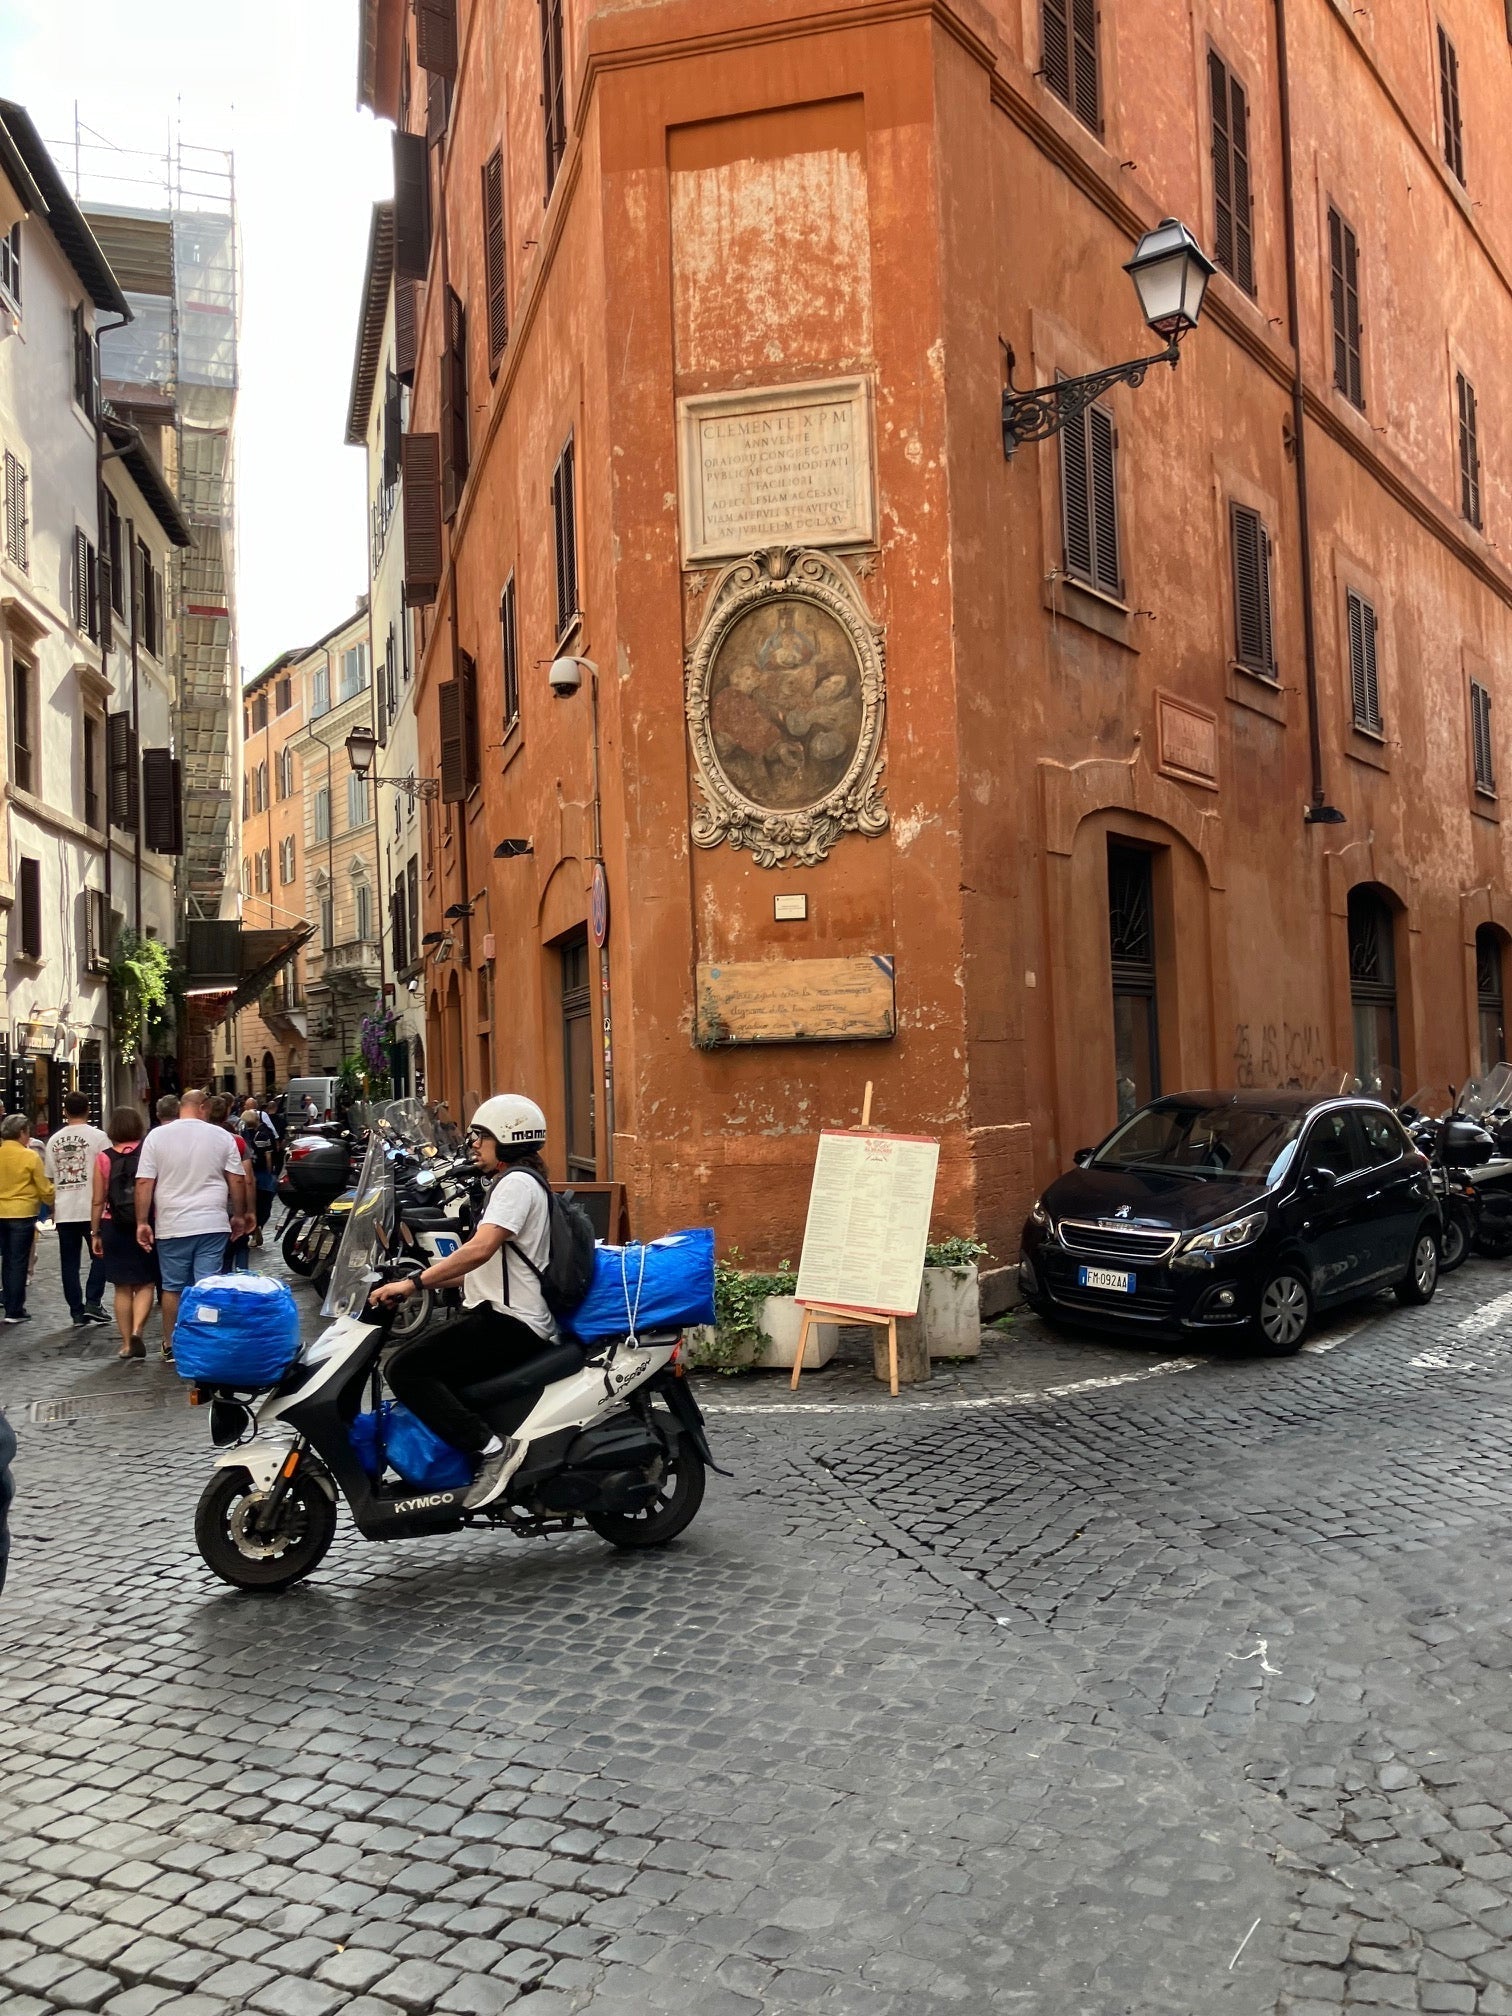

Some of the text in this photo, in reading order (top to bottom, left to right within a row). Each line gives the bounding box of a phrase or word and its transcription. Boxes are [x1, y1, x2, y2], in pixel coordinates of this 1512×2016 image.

[704, 417, 794, 439] CLEMENTE
[15, 1067, 24, 1110] PELL
[394, 1492, 454, 1513] KYMCO
